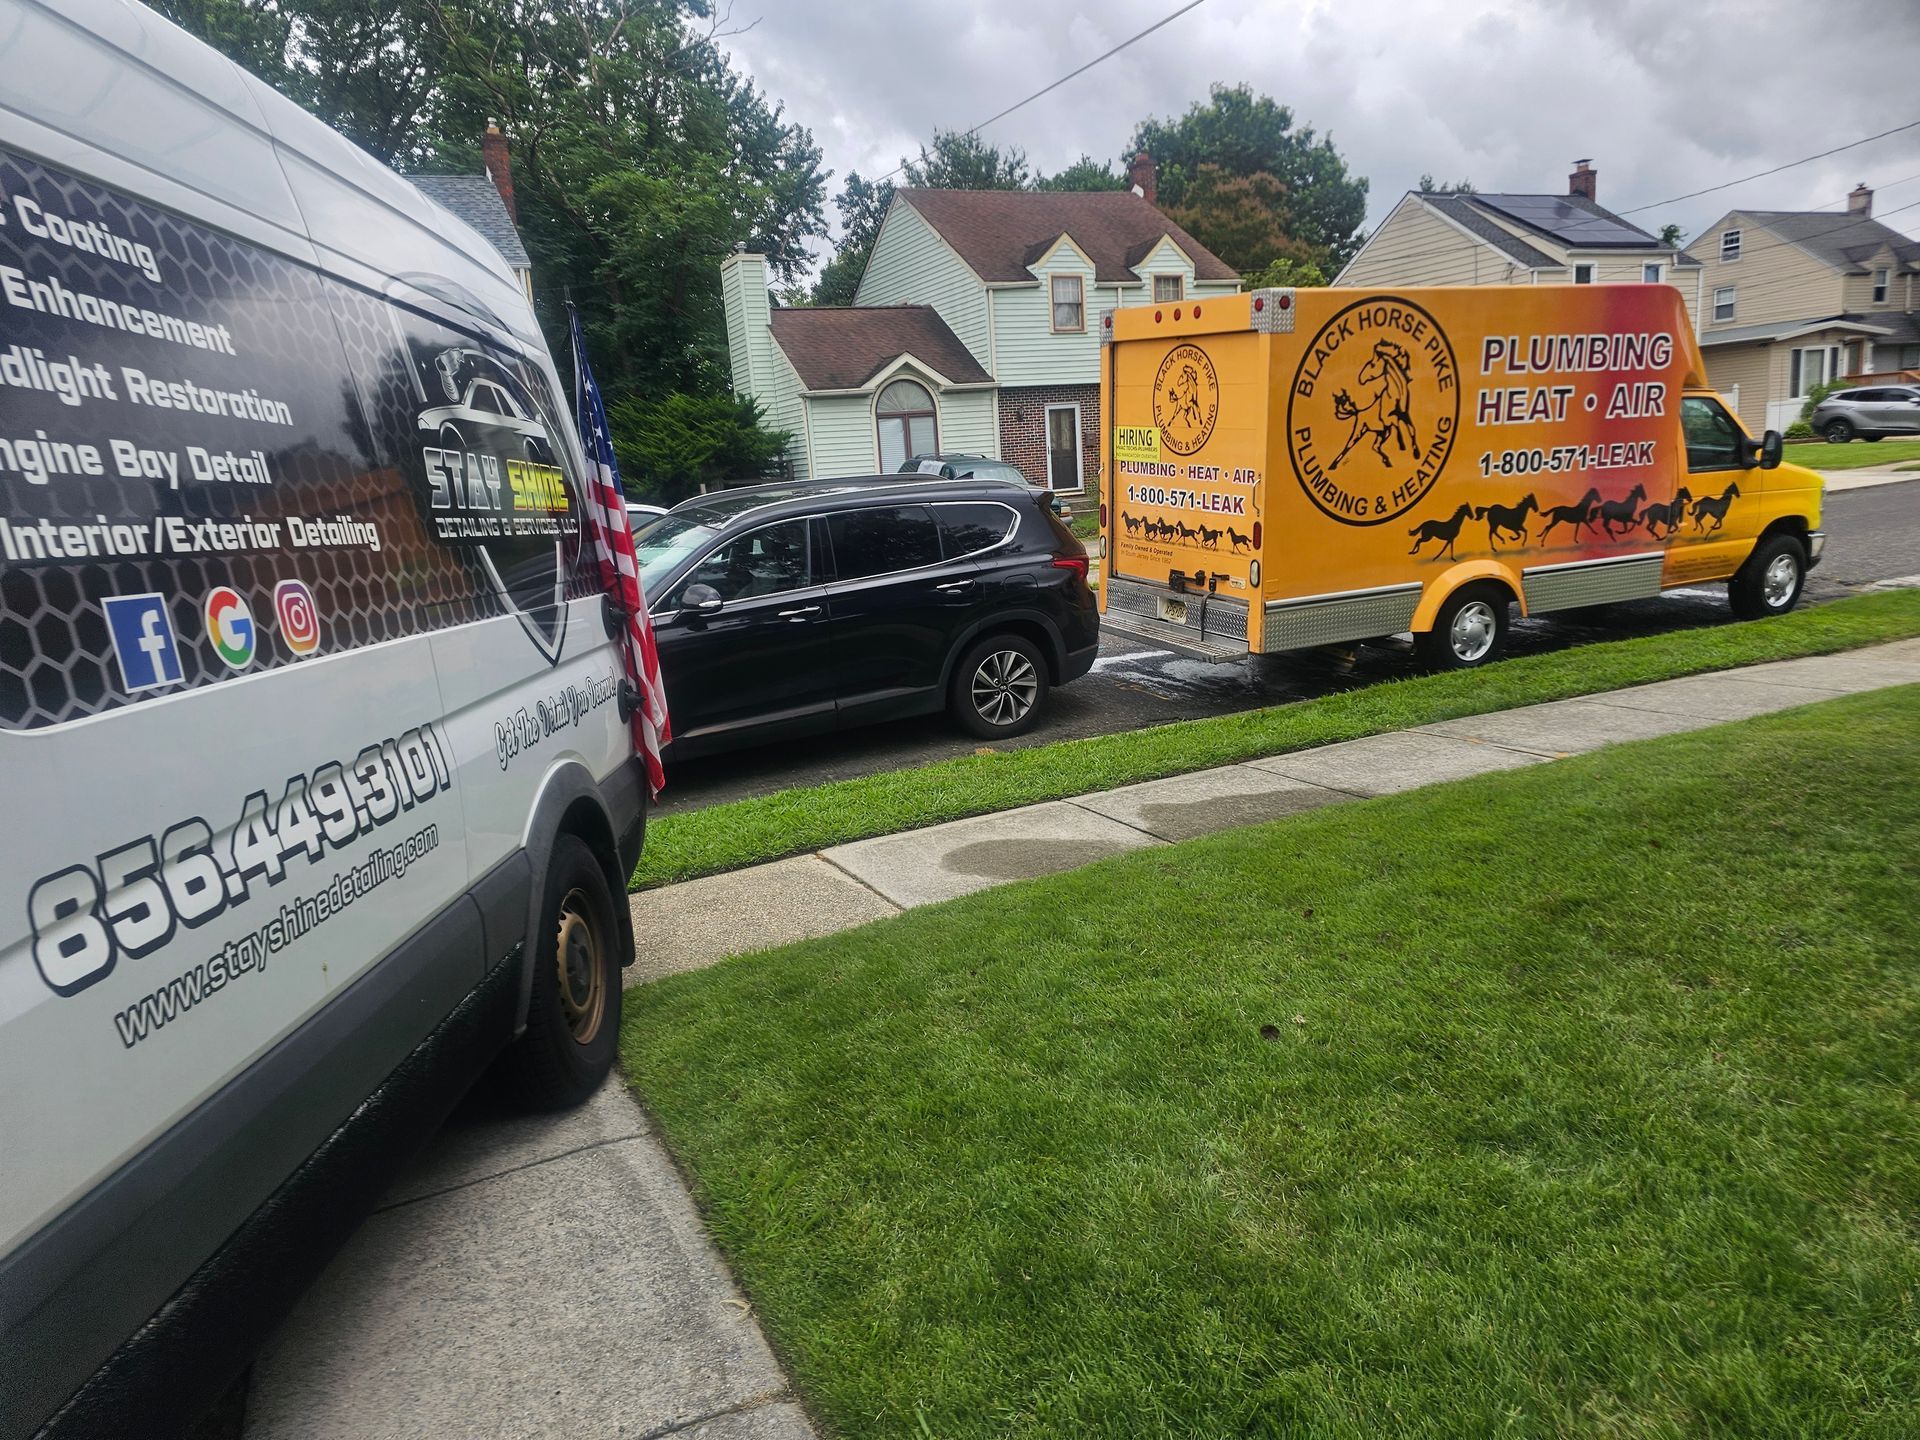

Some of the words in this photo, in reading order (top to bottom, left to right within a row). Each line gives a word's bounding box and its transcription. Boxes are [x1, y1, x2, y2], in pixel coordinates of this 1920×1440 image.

[14, 194, 163, 283] Coating
[0, 265, 237, 356] Enhancement
[1155, 357, 1176, 392] BLACK
[1176, 349, 1204, 366] HORSE
[1202, 362, 1216, 392] PIKE
[1297, 317, 1354, 398] BLACK
[1358, 307, 1427, 342] HORSE
[1424, 335, 1453, 393] PIKE
[1480, 333, 1673, 375] PLUMBING
[0, 344, 119, 407] dlight
[121, 367, 294, 426] Restoration
[1476, 385, 1575, 426] HEAT
[1605, 382, 1666, 419] AIR
[1119, 428, 1152, 446] HIRING
[1155, 404, 1183, 451] PLUMBING
[1185, 442, 1191, 451] &
[1191, 403, 1216, 449] HEATING
[109, 439, 180, 490] Bay
[186, 446, 273, 485] Detail
[423, 447, 501, 510] STAY
[506, 459, 569, 512] SHINE
[1120, 460, 1176, 478] PLUMBING
[1187, 465, 1220, 482] HEAT
[1233, 469, 1256, 484] AIR
[1295, 426, 1368, 516] PLUMBING
[1375, 495, 1388, 514] &
[1392, 415, 1452, 507] HEATING
[1479, 441, 1656, 478] 1-800-571-LEAK
[1127, 485, 1246, 515] 1-800-571-LEAK
[0, 515, 282, 560] Interior/Exterior
[287, 515, 381, 551] Detailing
[435, 517, 501, 538] DETAILING
[563, 518, 579, 534] LLC
[1120, 542, 1134, 550] Family
[494, 717, 519, 771] Get
[515, 706, 540, 749] The
[536, 691, 571, 737] Detail
[566, 685, 590, 727] You
[28, 723, 451, 998] 856.449.3101
[114, 824, 439, 1048] www.stayshinedetailing.com
